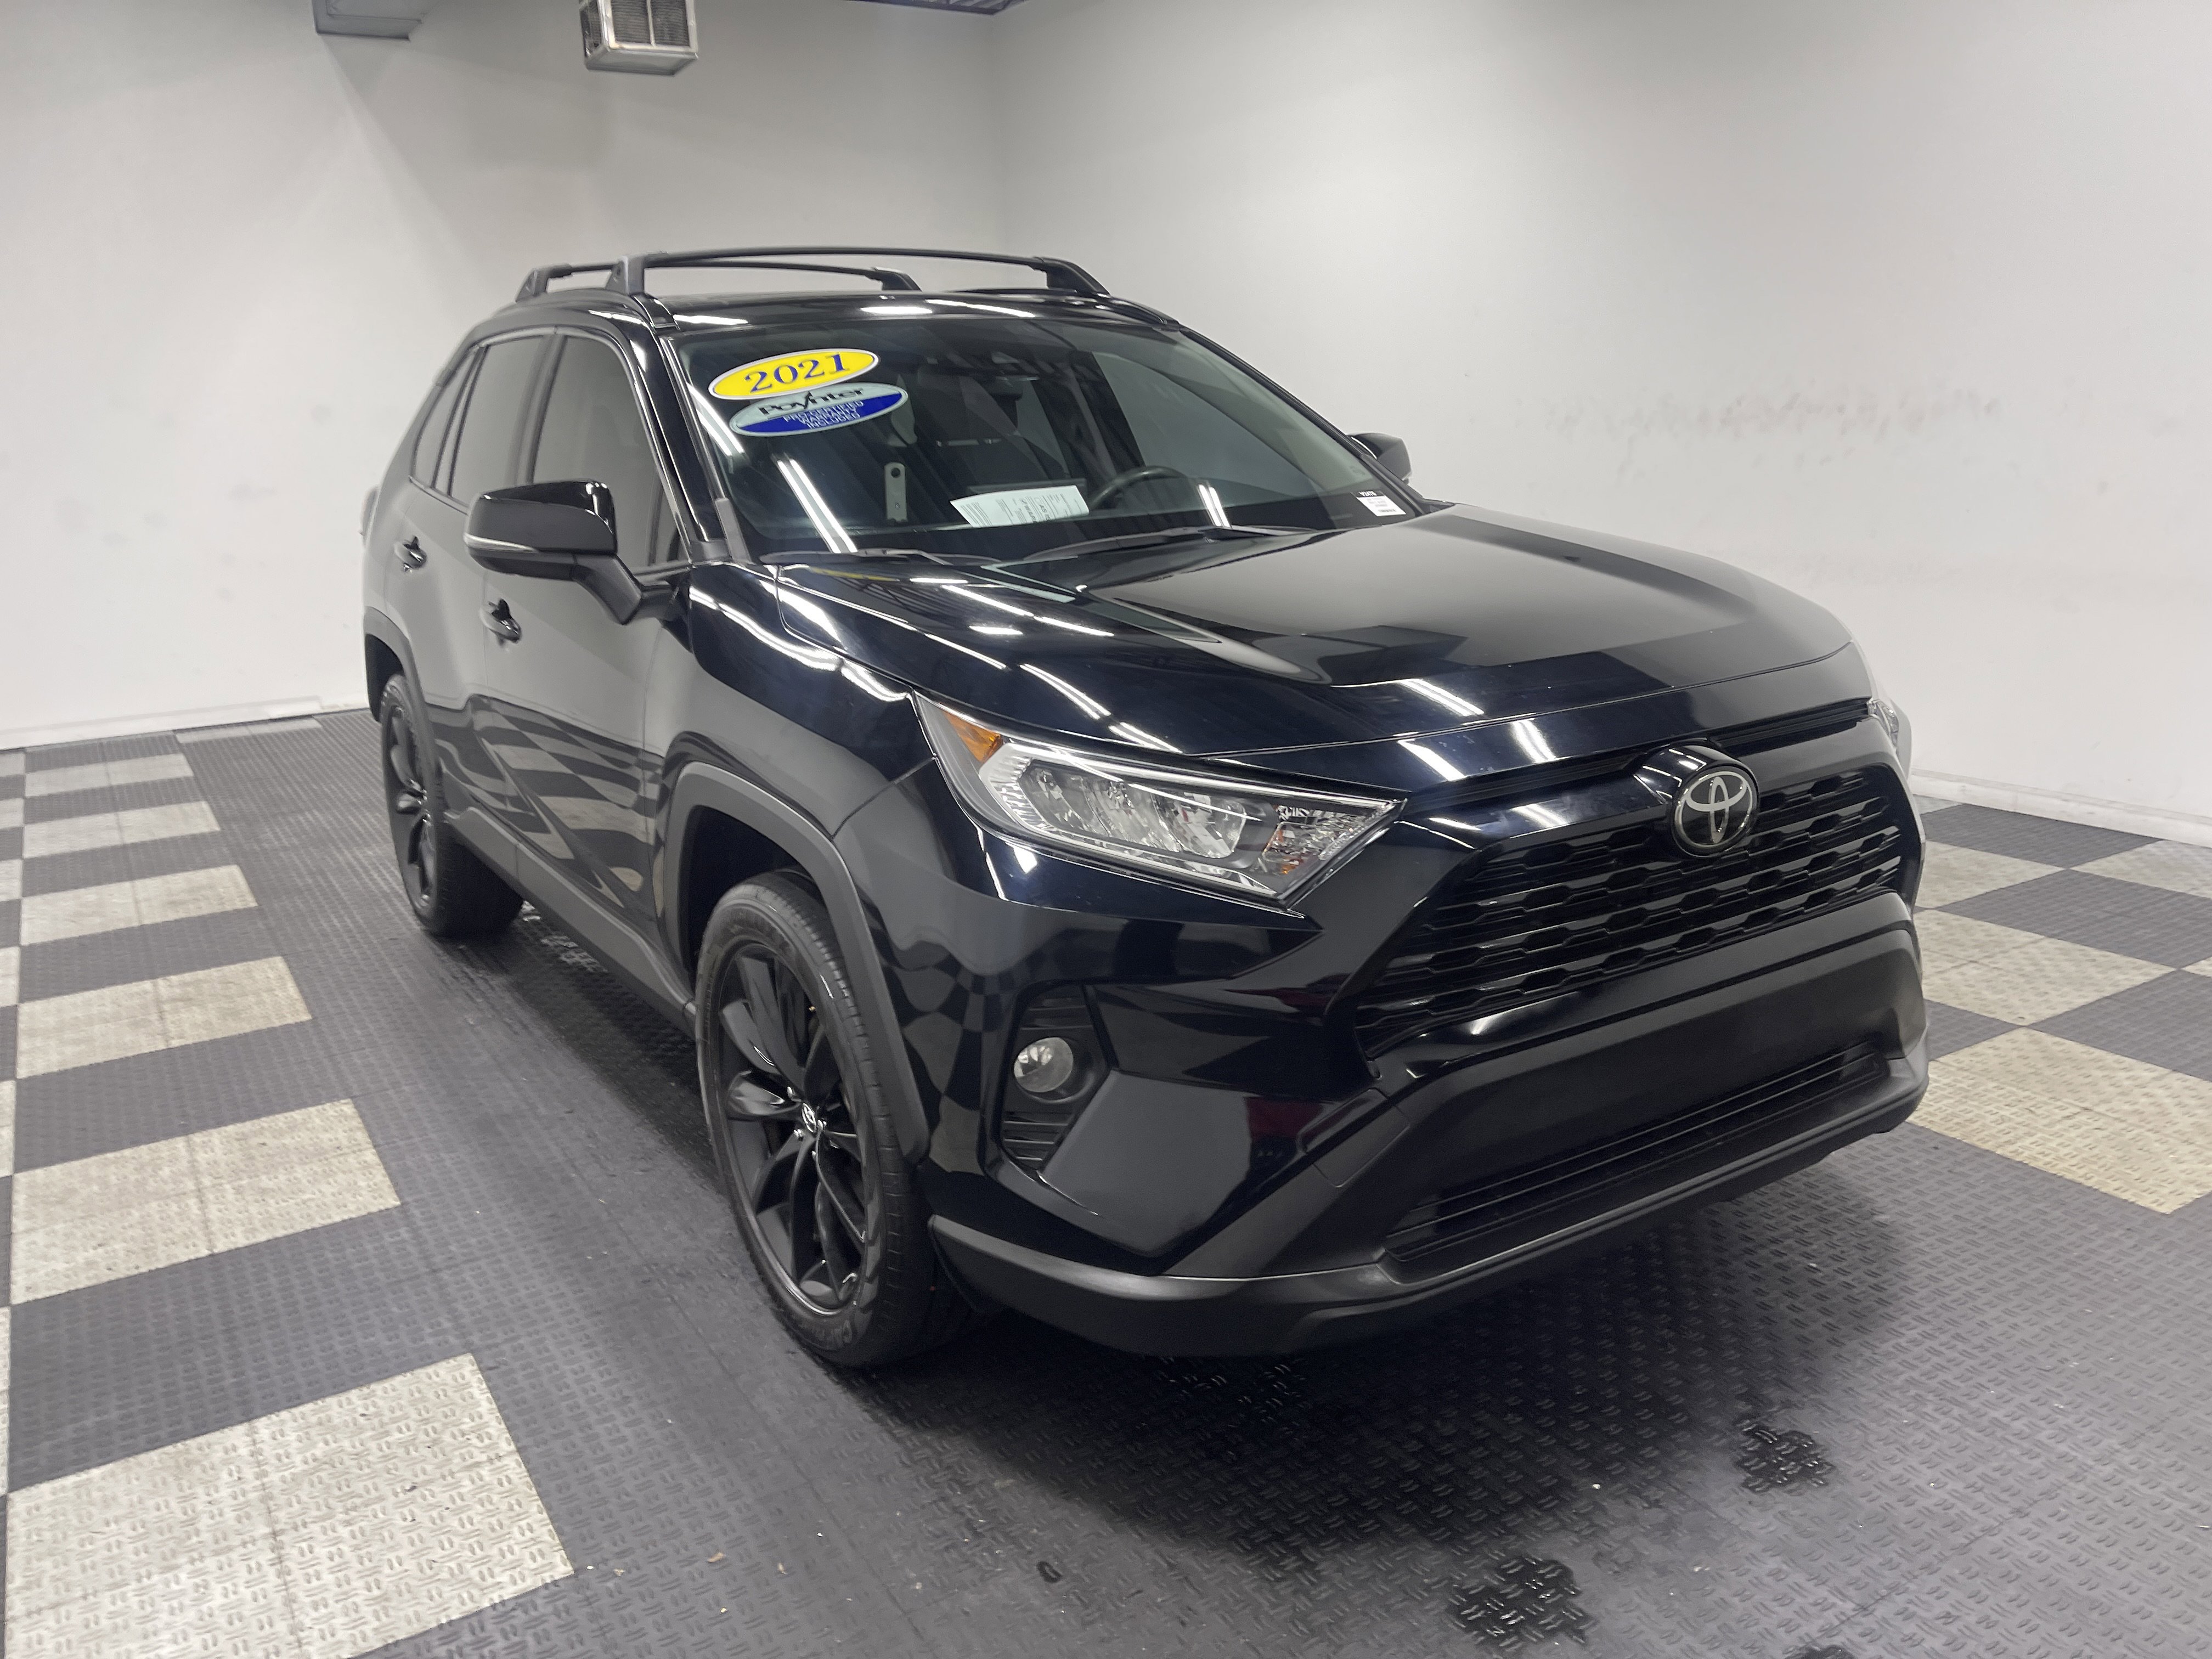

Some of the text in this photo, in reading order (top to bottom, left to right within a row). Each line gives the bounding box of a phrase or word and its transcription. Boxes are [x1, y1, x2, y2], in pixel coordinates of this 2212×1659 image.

[745, 353, 851, 393] 2021
[758, 387, 864, 414] Poynter
[797, 407, 857, 425] WARRANTY
[806, 412, 861, 430] INCLUDED
